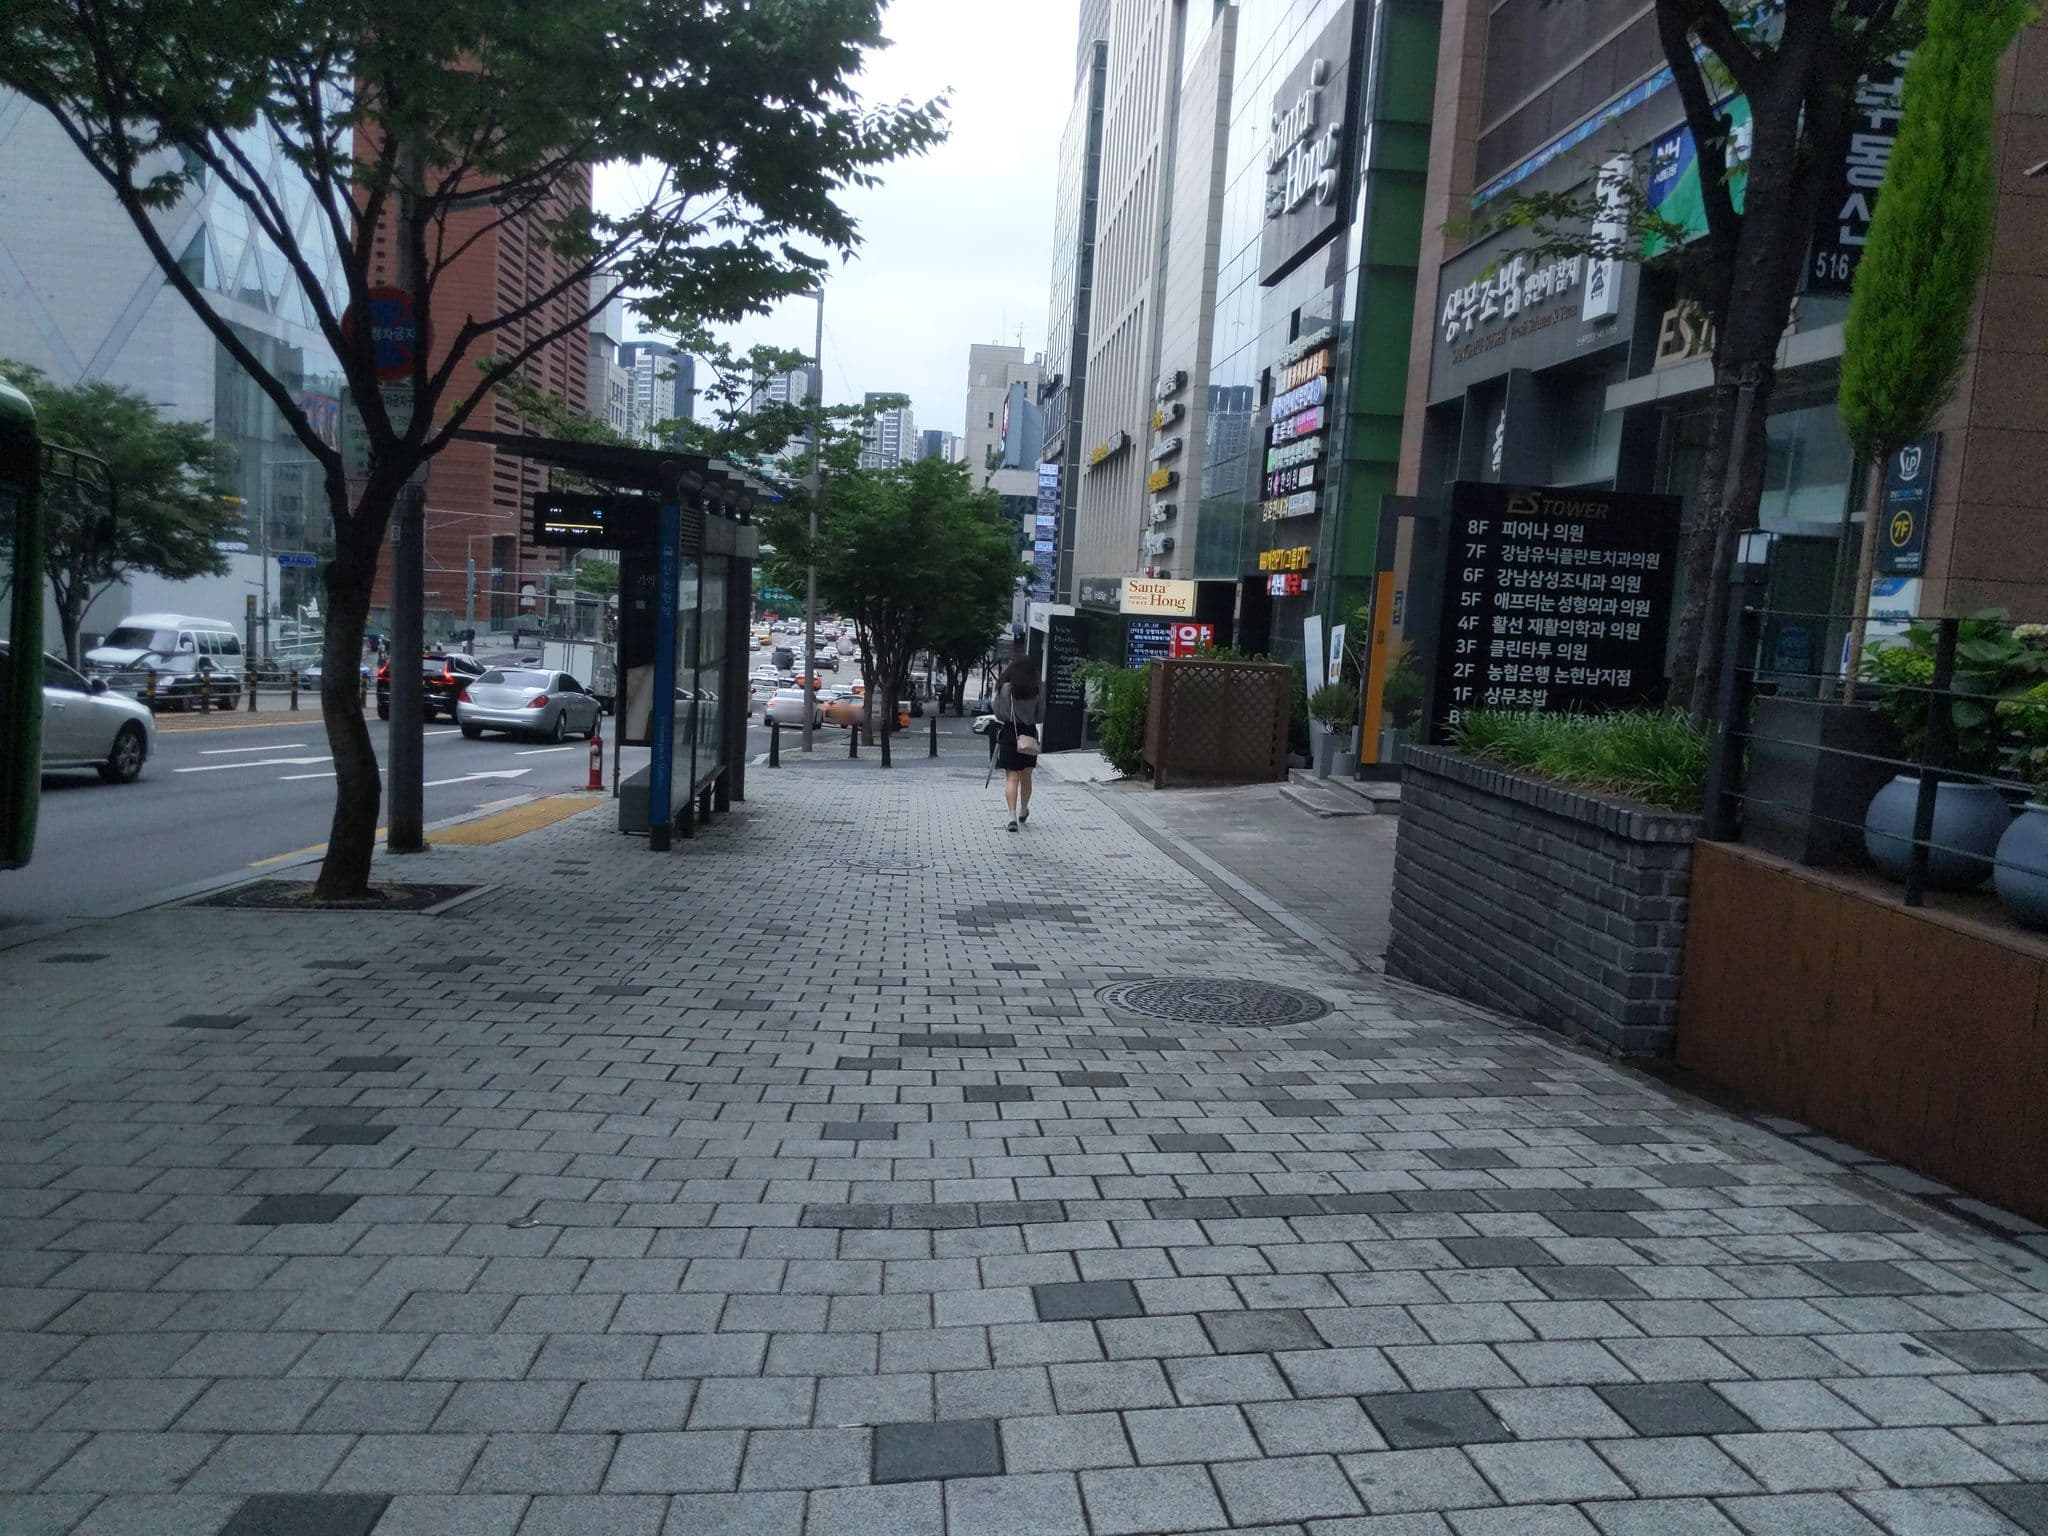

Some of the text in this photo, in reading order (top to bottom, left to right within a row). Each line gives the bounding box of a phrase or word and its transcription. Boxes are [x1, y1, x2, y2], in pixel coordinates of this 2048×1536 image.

[1283, 122, 1340, 214] Hong
[1815, 252, 1848, 280] 516
[1442, 256, 1526, 343] 상무초밥
[1542, 499, 1608, 520] TOWER
[1467, 520, 1585, 542] 8F 피어나 의원
[1893, 520, 1910, 546] 7F
[1465, 544, 1660, 569] 7F 강남유닉플란트치과의원
[1128, 580, 1166, 594] Santa
[1462, 568, 1642, 593] 6F 강남삼성조내과 의원
[1150, 594, 1186, 612] Hong
[1460, 591, 1650, 618] 5F 애프터눈 성형외과 의원
[1457, 615, 1480, 631] 4F
[1527, 618, 1606, 639] 재활의학과
[1610, 622, 1641, 640] 의원
[1455, 639, 1588, 661] 3F 클린타투 의원
[1453, 663, 1631, 687] 2F 농협은행 논현남지점
[1453, 687, 1549, 707] 1F 상무초밥
